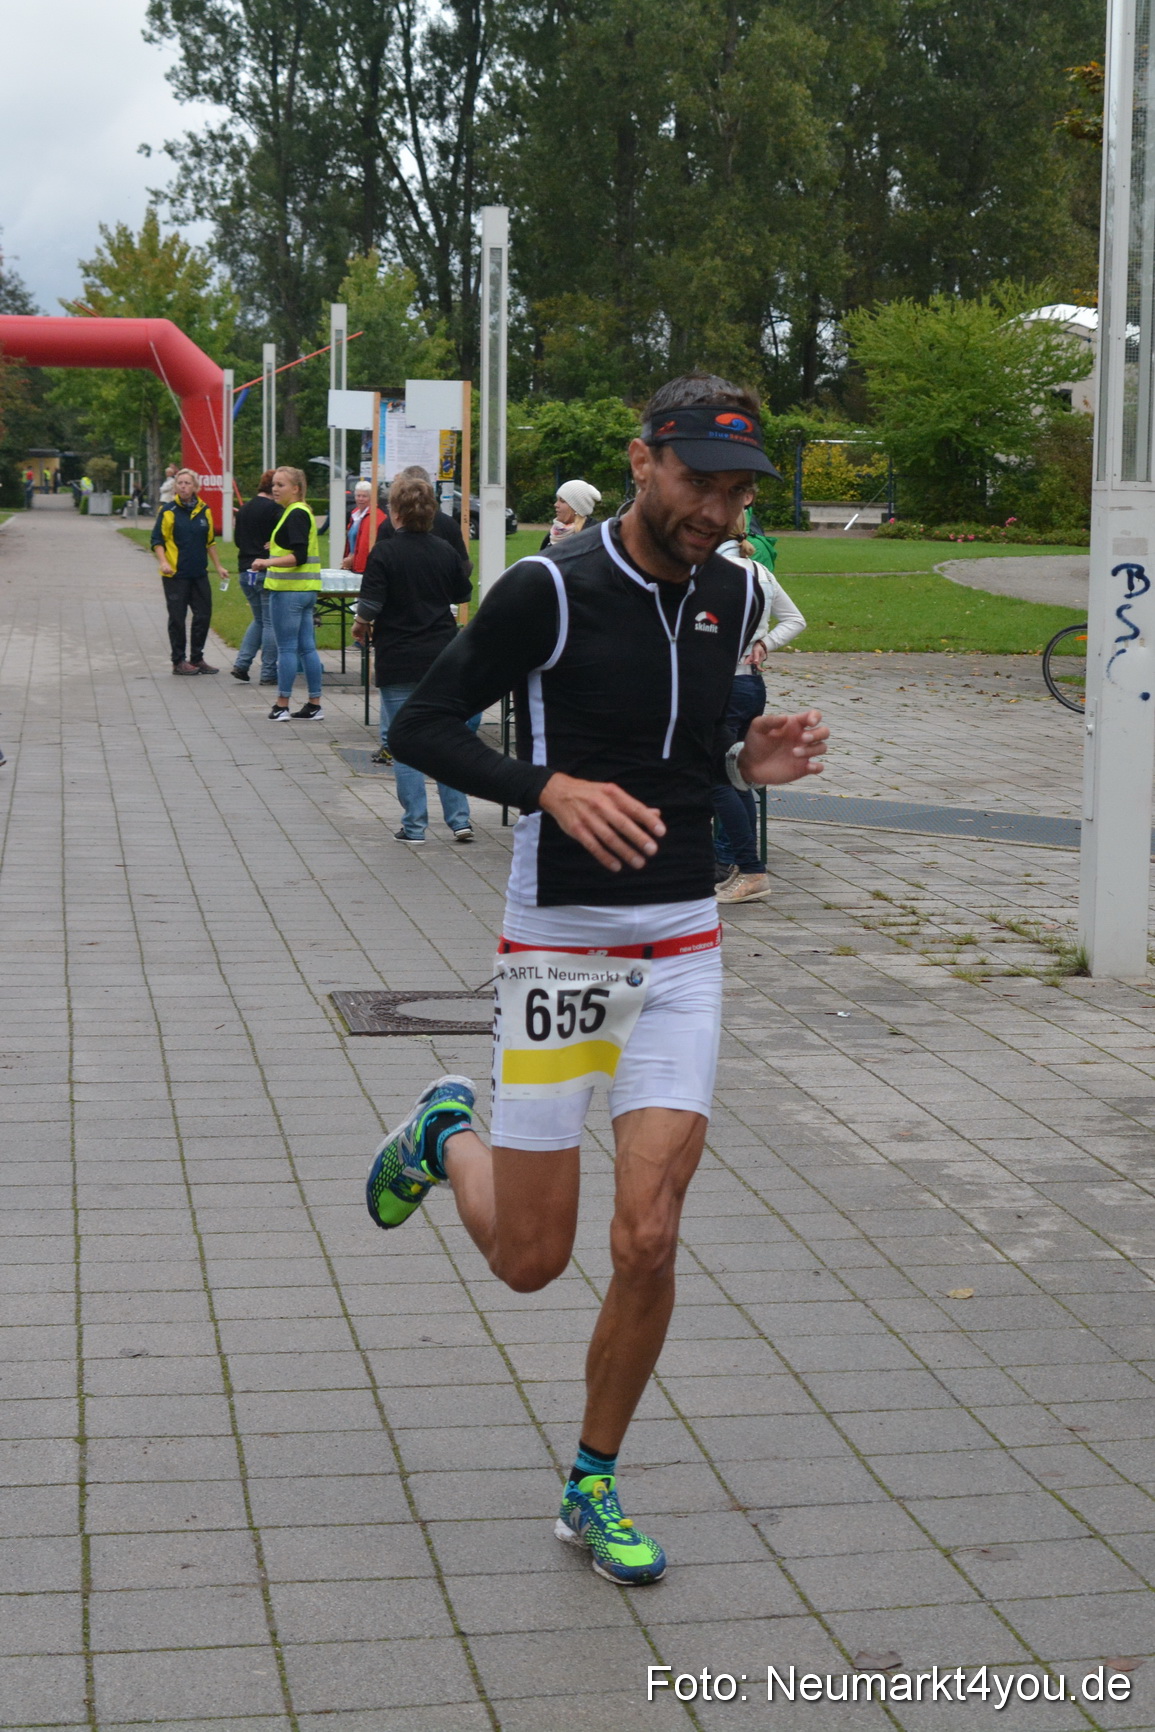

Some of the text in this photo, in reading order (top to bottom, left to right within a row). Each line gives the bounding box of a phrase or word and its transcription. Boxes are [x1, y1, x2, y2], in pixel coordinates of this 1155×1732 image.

[694, 622, 719, 634] skinfit
[548, 967, 620, 982] Neumarkt
[525, 988, 610, 1042] 655
